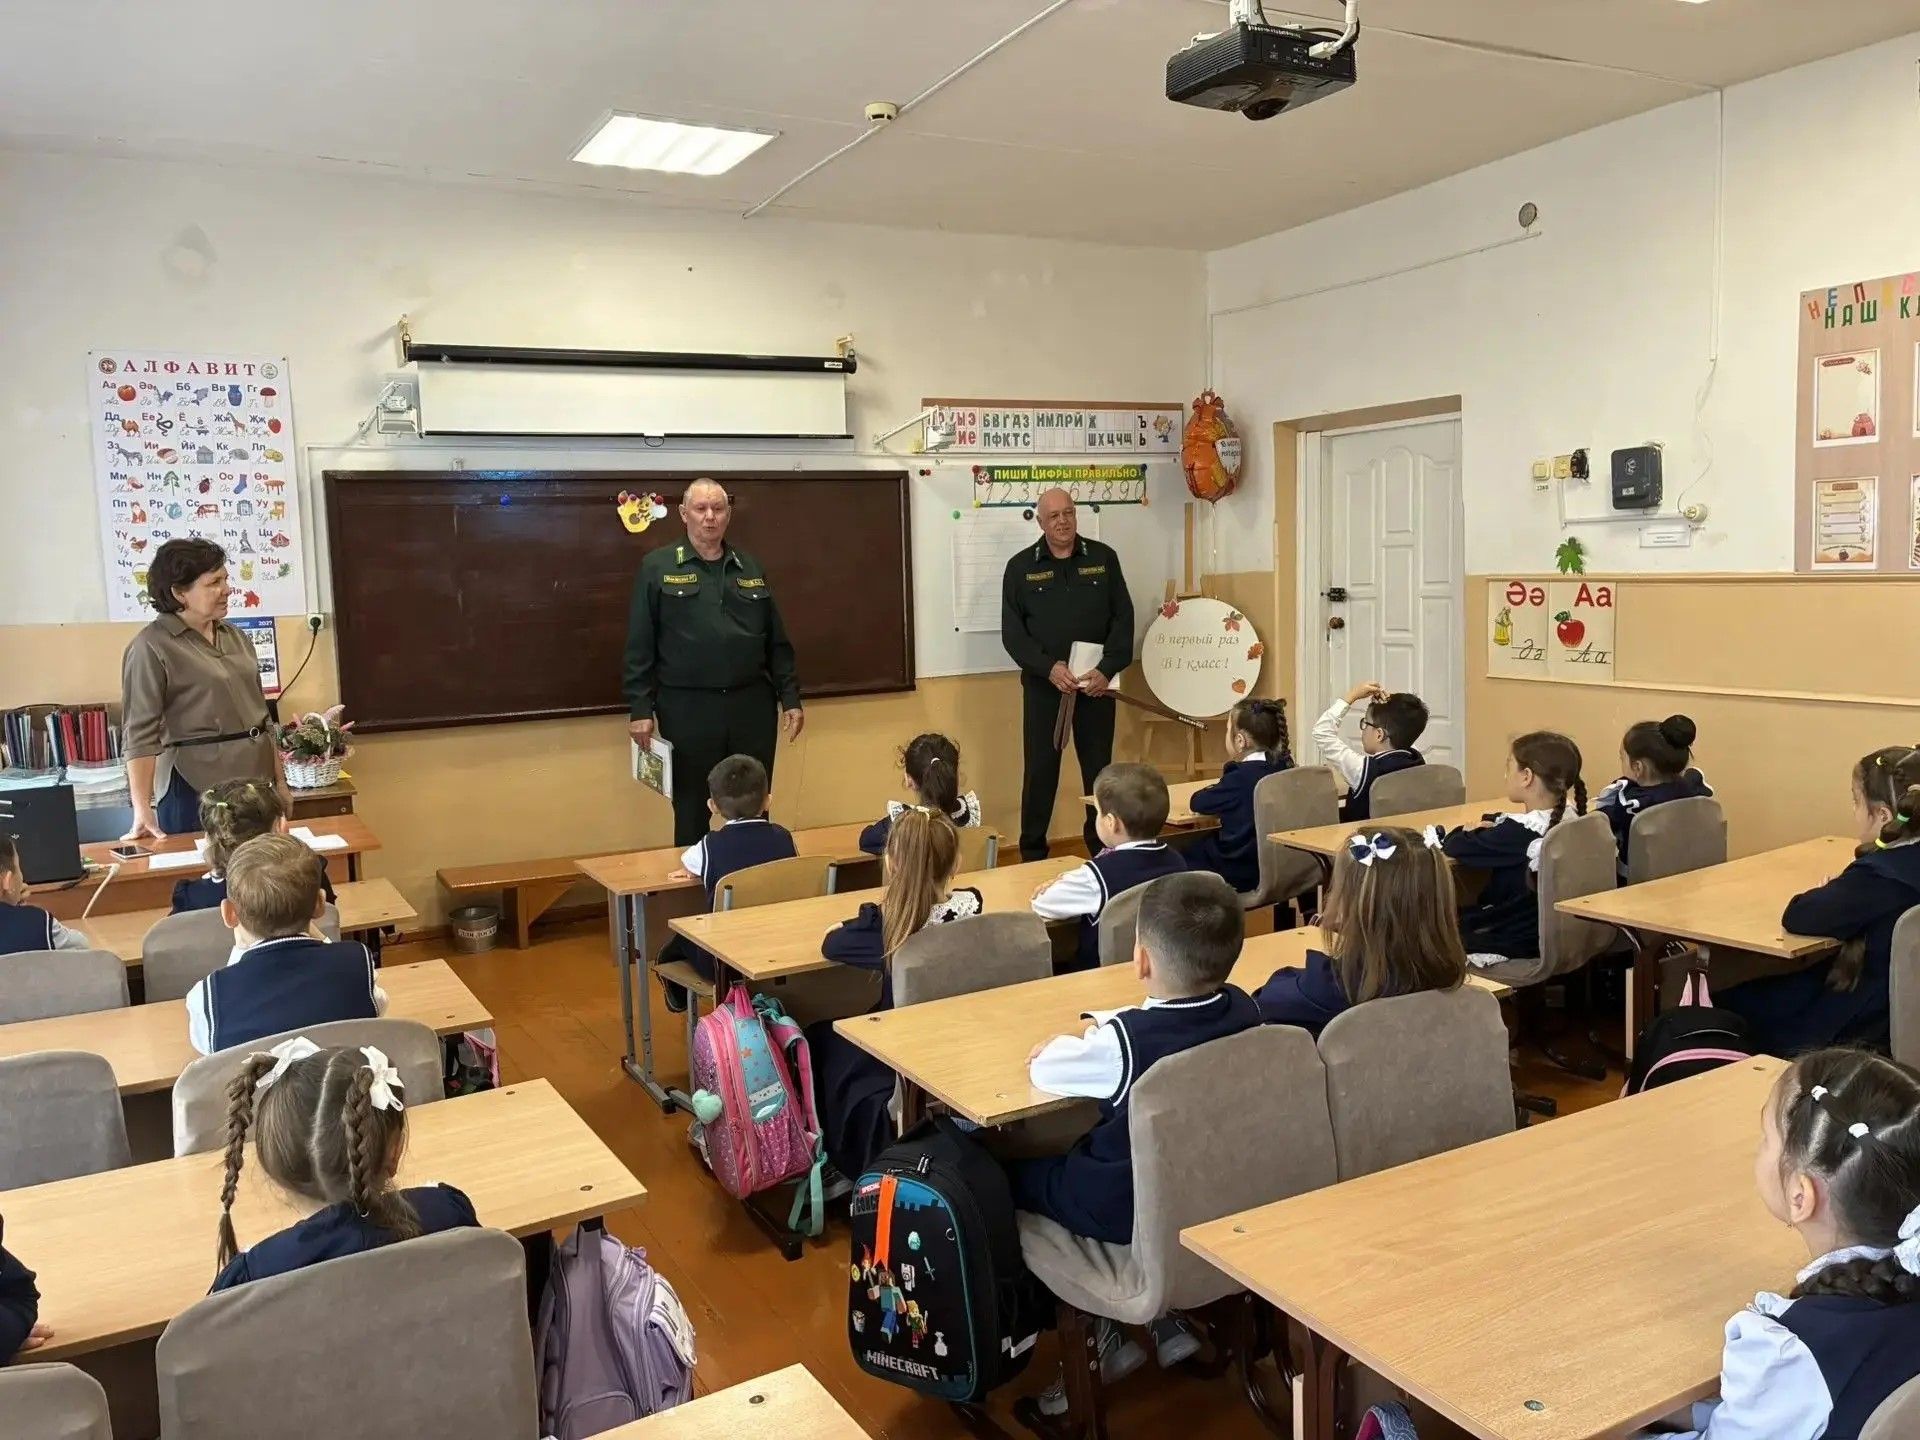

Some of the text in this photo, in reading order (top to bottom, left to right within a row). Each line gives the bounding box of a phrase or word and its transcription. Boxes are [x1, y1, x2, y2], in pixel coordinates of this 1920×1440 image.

[1824, 299, 1878, 329] НАШ
[123, 359, 256, 376] АЛФАВИТ
[102, 380, 117, 389] Аа
[176, 382, 191, 391] Бб
[211, 383, 226, 392] Вв
[247, 384, 258, 393] Гг
[104, 412, 120, 421] Дд
[142, 412, 155, 421] Ее
[213, 414, 231, 422] Жж
[1137, 415, 1147, 429] Ъ
[107, 440, 120, 449] Зз
[144, 441, 159, 450] Ии
[216, 442, 229, 450] Кк
[251, 443, 266, 451] Лл
[1139, 433, 1147, 446] Ь
[110, 472, 128, 480] Мм
[146, 472, 162, 480] Нн
[219, 472, 234, 480] Оо
[994, 469, 1028, 480] ПИШИ
[1031, 468, 1072, 481] ЦИФРЫ
[1102, 480, 1113, 501] 8
[1119, 480, 1130, 501] 9
[112, 499, 269, 509] Пп Рр Сс Тт Уу
[152, 530, 171, 538] Фф
[188, 529, 202, 537] Хх
[259, 529, 273, 538] Цц
[261, 556, 280, 565] Ыы
[1506, 581, 1613, 608] Әә Аа
[1169, 633, 1213, 648] первый
[1218, 636, 1240, 648] раз
[866, 1349, 939, 1380] MINECRAFT
